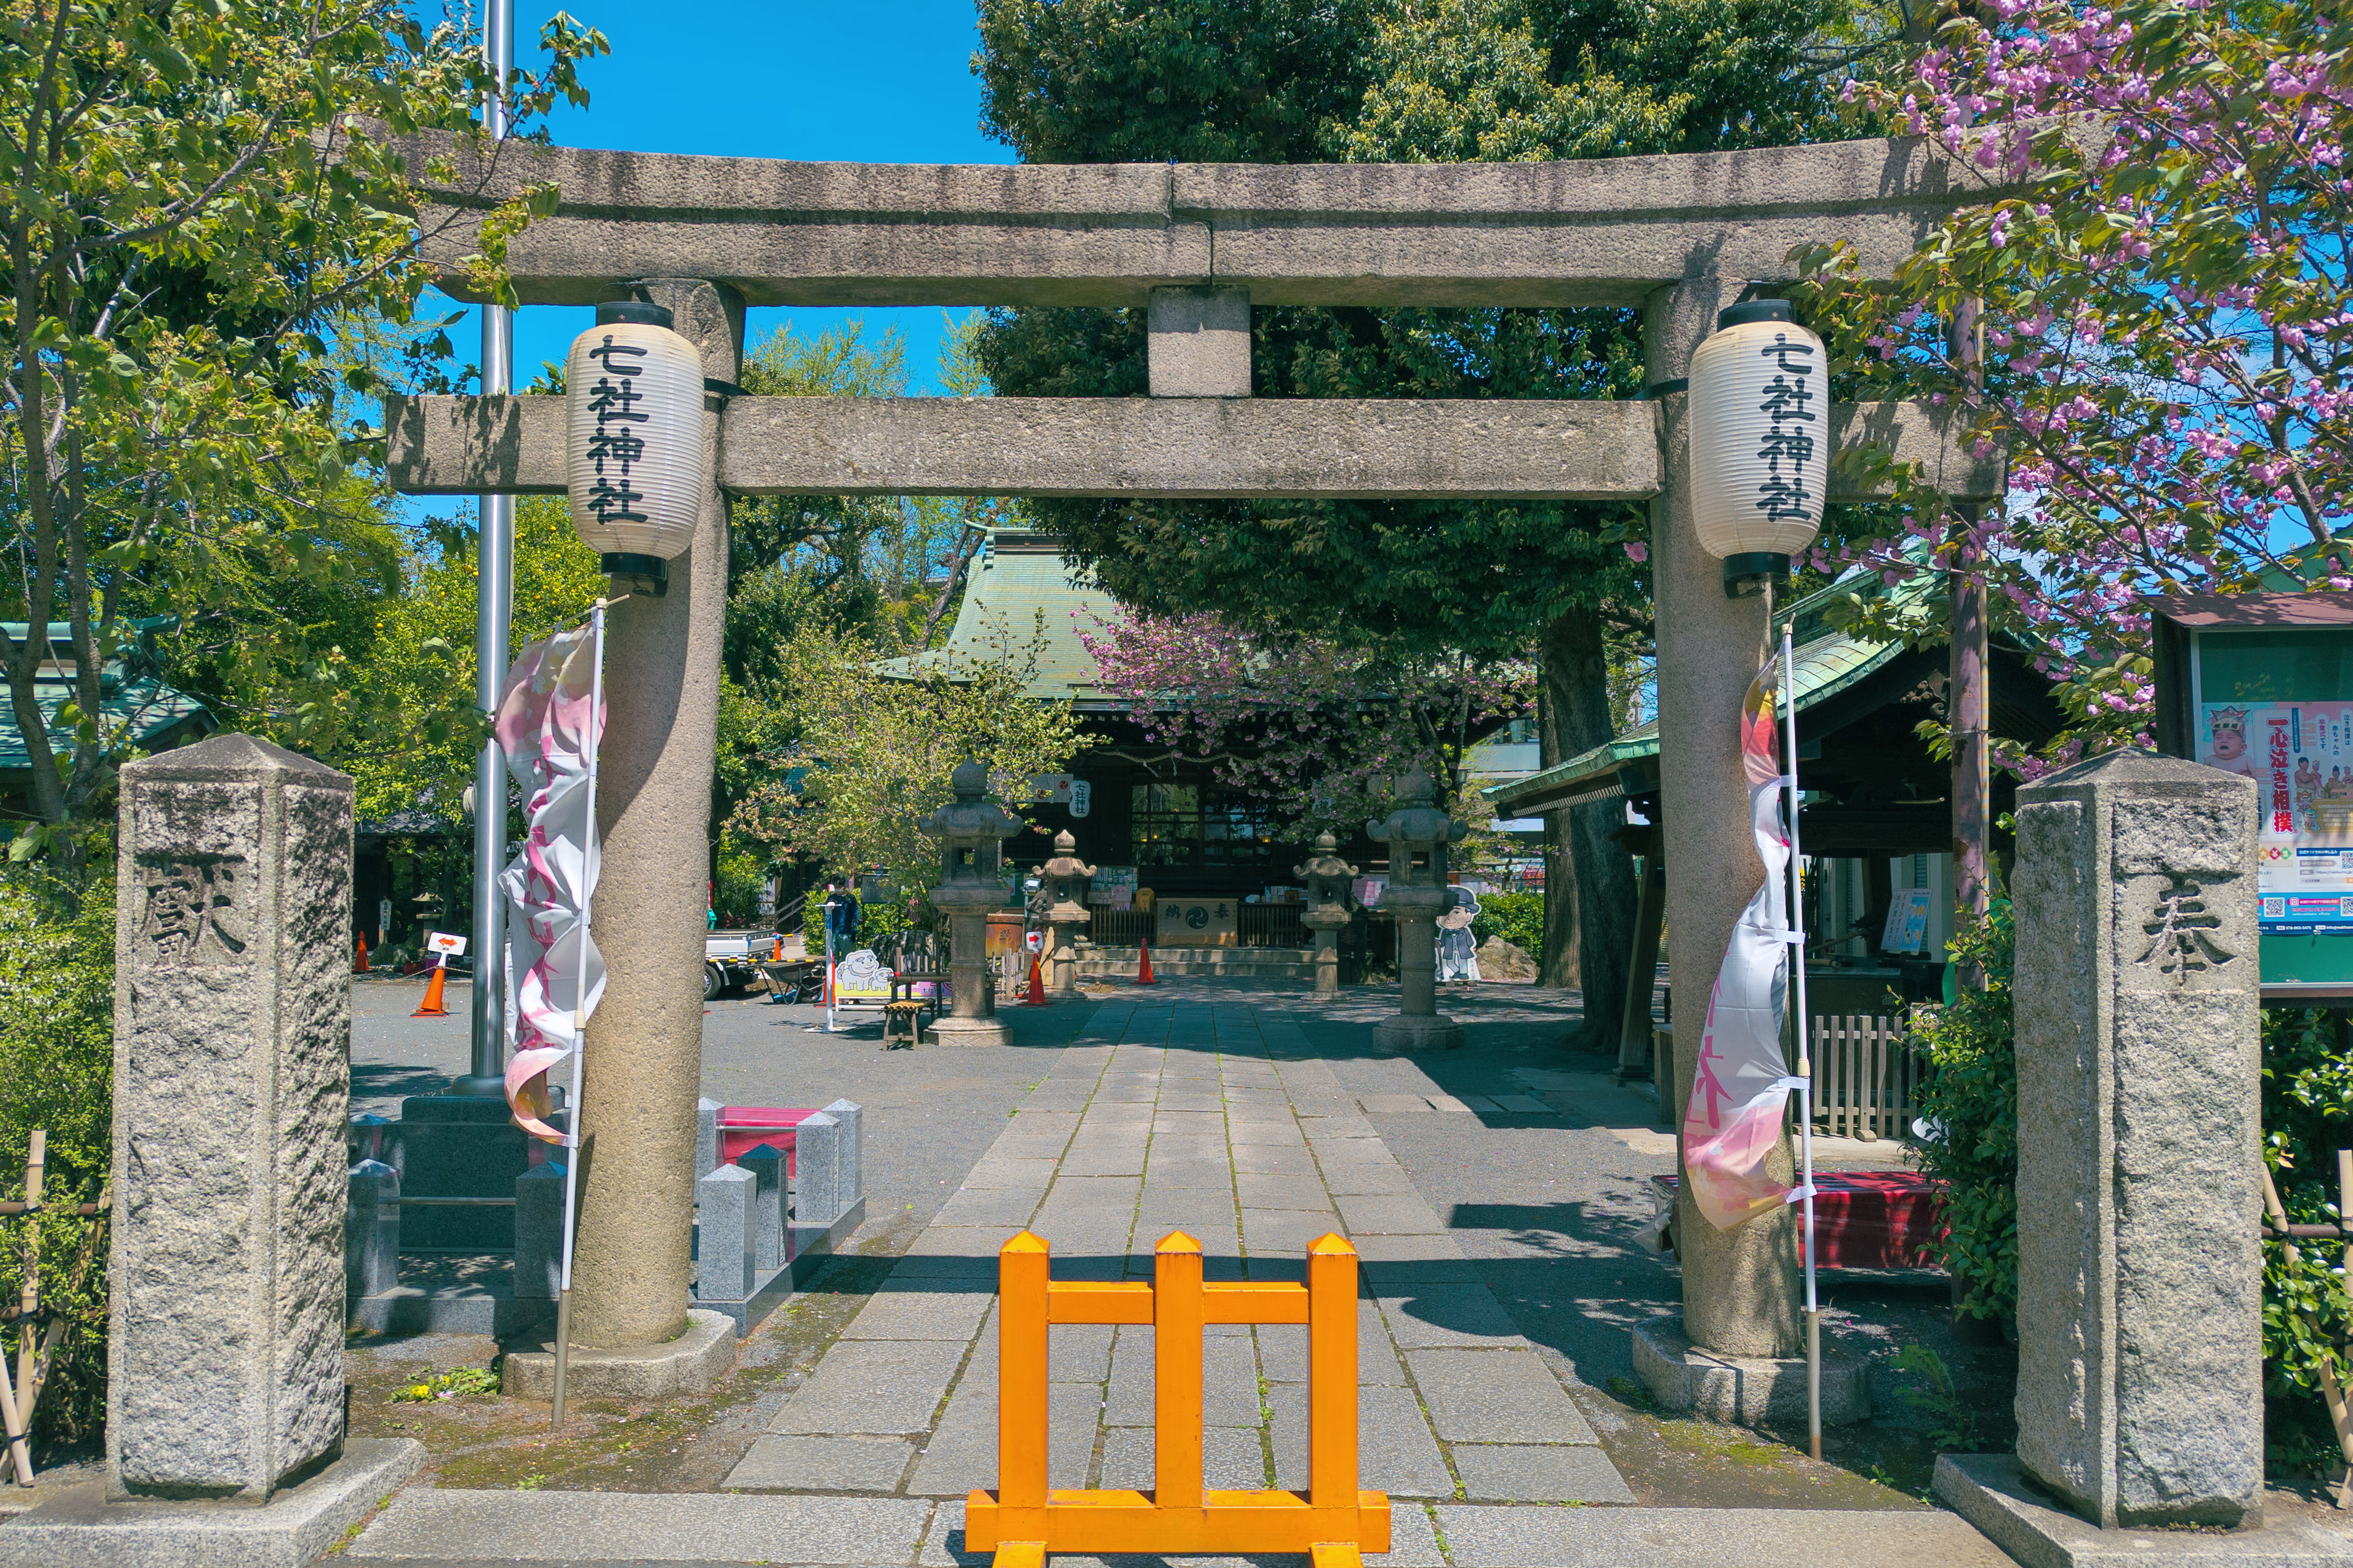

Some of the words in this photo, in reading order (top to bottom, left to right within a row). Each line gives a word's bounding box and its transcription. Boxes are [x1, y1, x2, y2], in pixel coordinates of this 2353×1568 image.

[587, 335, 649, 525] 七社神社
[1756, 333, 1815, 522] 七社神社
[2319, 719, 2327, 751] 卒業式です。
[1075, 783, 1086, 814] 七社神社
[2267, 718, 2293, 833] 一心泣き相撲
[1165, 904, 1181, 919] 納
[1214, 903, 1229, 920] 奉
[2135, 879, 2237, 986] 奉
